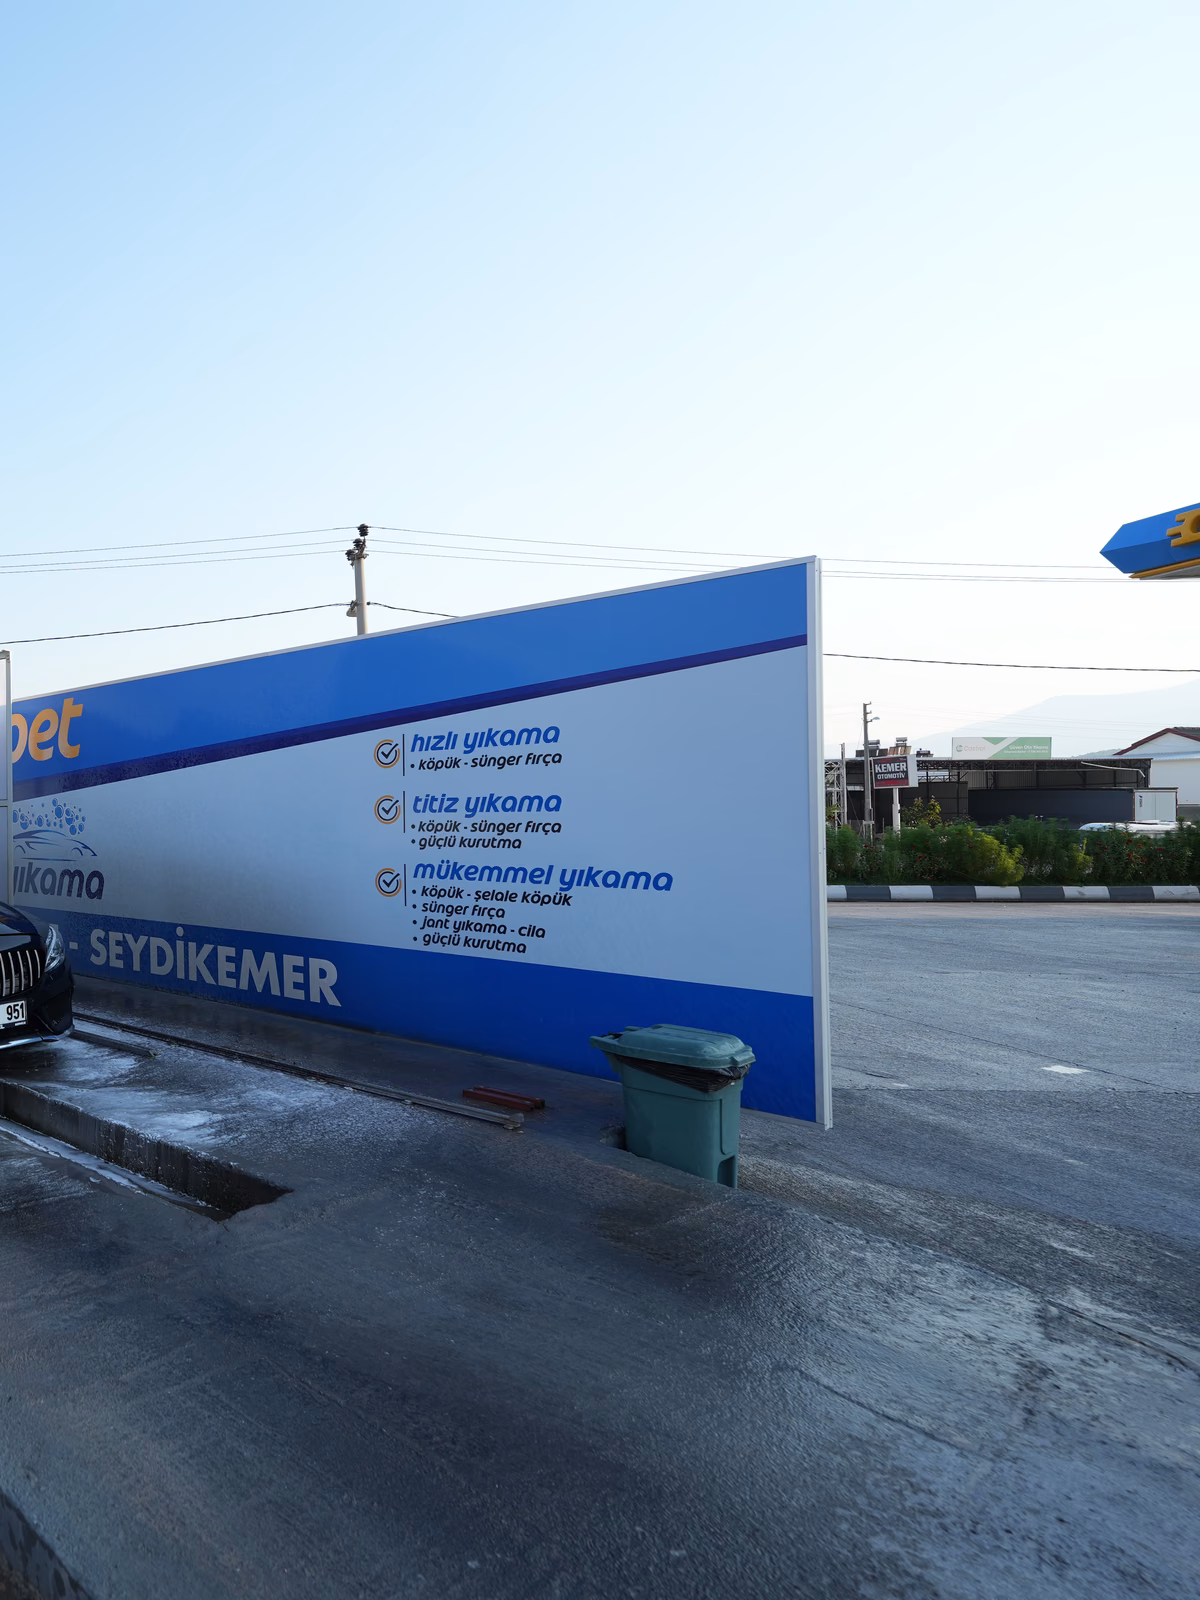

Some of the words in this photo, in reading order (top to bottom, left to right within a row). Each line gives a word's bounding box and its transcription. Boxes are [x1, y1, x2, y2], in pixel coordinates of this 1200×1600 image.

[410, 731, 458, 752] hızlı
[463, 726, 560, 754] yıkama
[418, 757, 462, 771] köpük
[471, 755, 522, 769] sünger
[525, 753, 562, 767] fırça
[875, 762, 907, 773] KEMER
[877, 772, 906, 780] OTOMOTİV
[412, 794, 459, 813] titiz
[464, 793, 562, 818] yıkama
[418, 820, 461, 834] köpük
[470, 820, 522, 836] sünger
[524, 821, 562, 835] fırça
[418, 836, 456, 850] güçlü
[459, 837, 522, 849] kurutma
[413, 859, 554, 885] mükemmel
[559, 866, 674, 892] yıkama
[421, 885, 464, 899] köpük
[474, 890, 518, 902] şelale
[521, 891, 572, 906] köpük
[421, 901, 469, 917] sünger
[471, 905, 506, 919] fırça
[420, 916, 450, 930] jant
[453, 920, 507, 935] yıkama
[518, 925, 546, 938] cila
[422, 933, 460, 947] güçlü
[463, 936, 527, 953] kurutma
[90, 926, 342, 1007] SEYDİKEMER
[6, 1002, 25, 1021] 951
